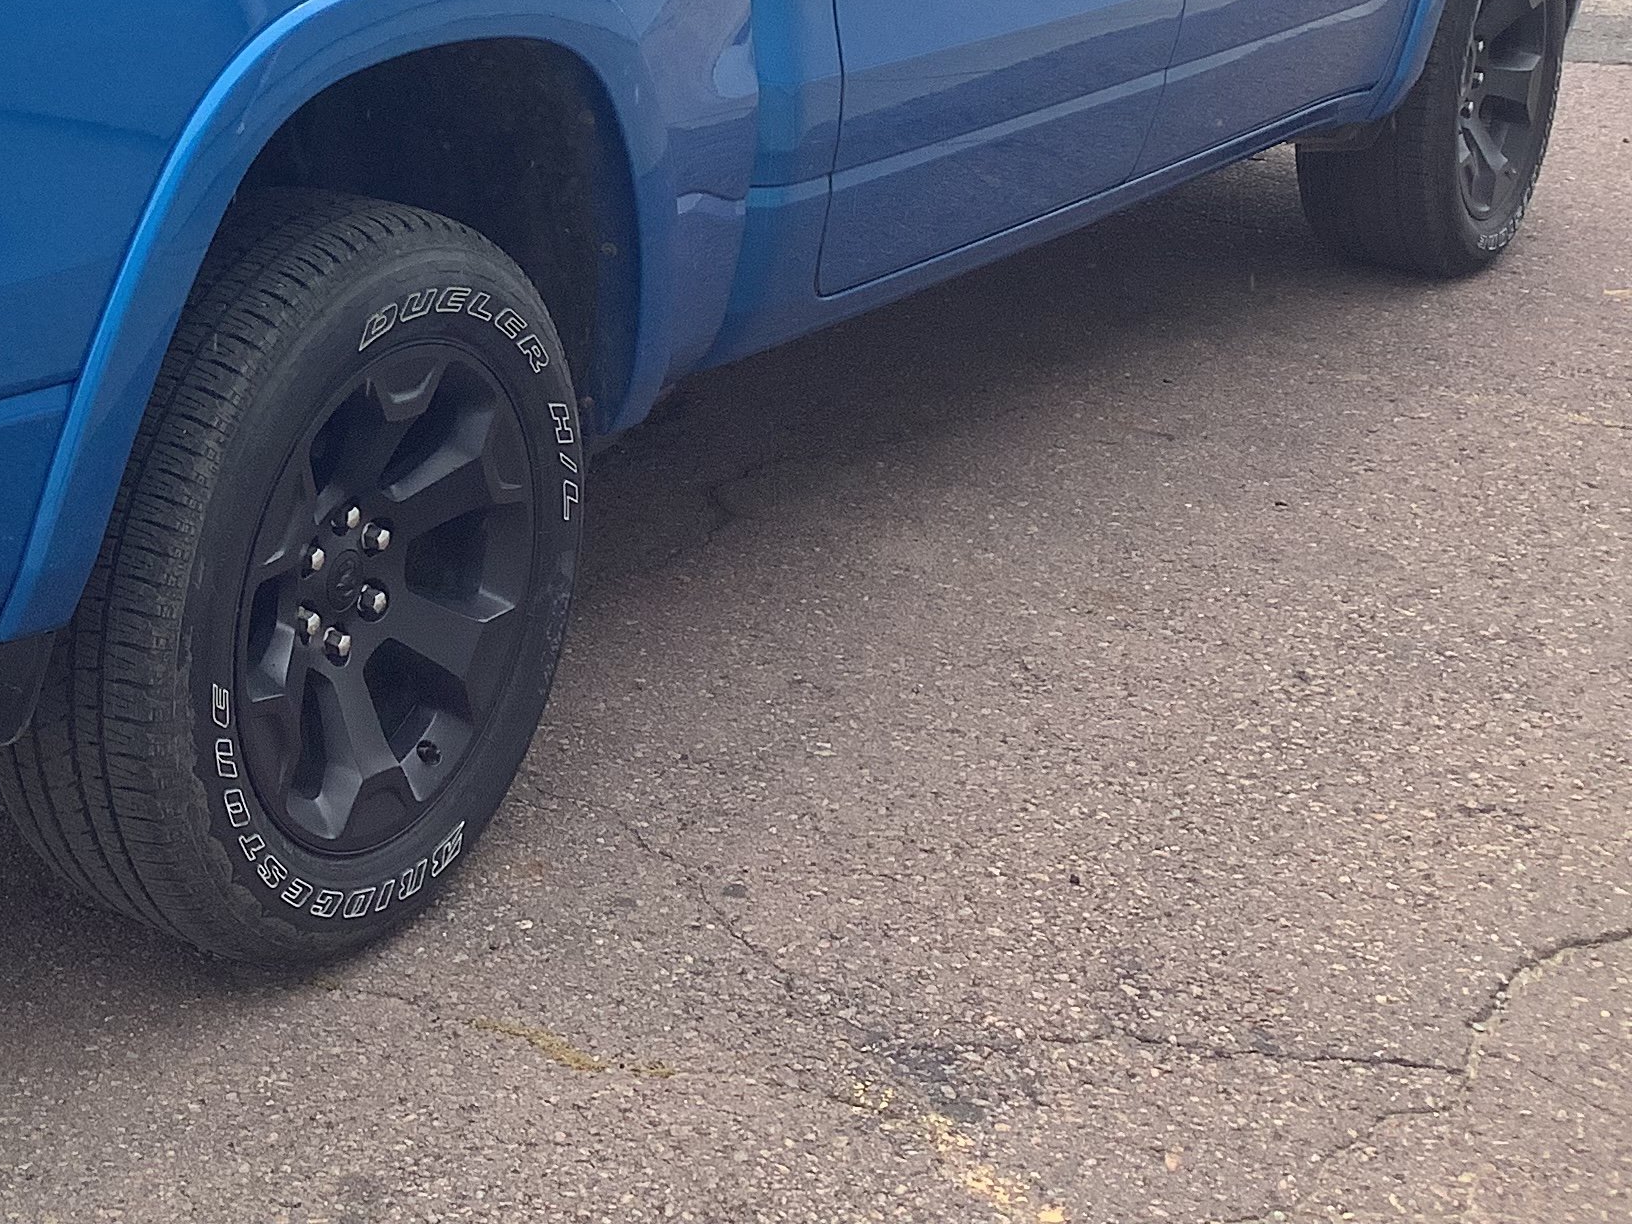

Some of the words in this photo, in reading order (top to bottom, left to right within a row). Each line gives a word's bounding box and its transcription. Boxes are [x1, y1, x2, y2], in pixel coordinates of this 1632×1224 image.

[357, 286, 550, 374] DUELER
[548, 402, 579, 521] H/L
[212, 683, 466, 919] BRIDGESTONE
